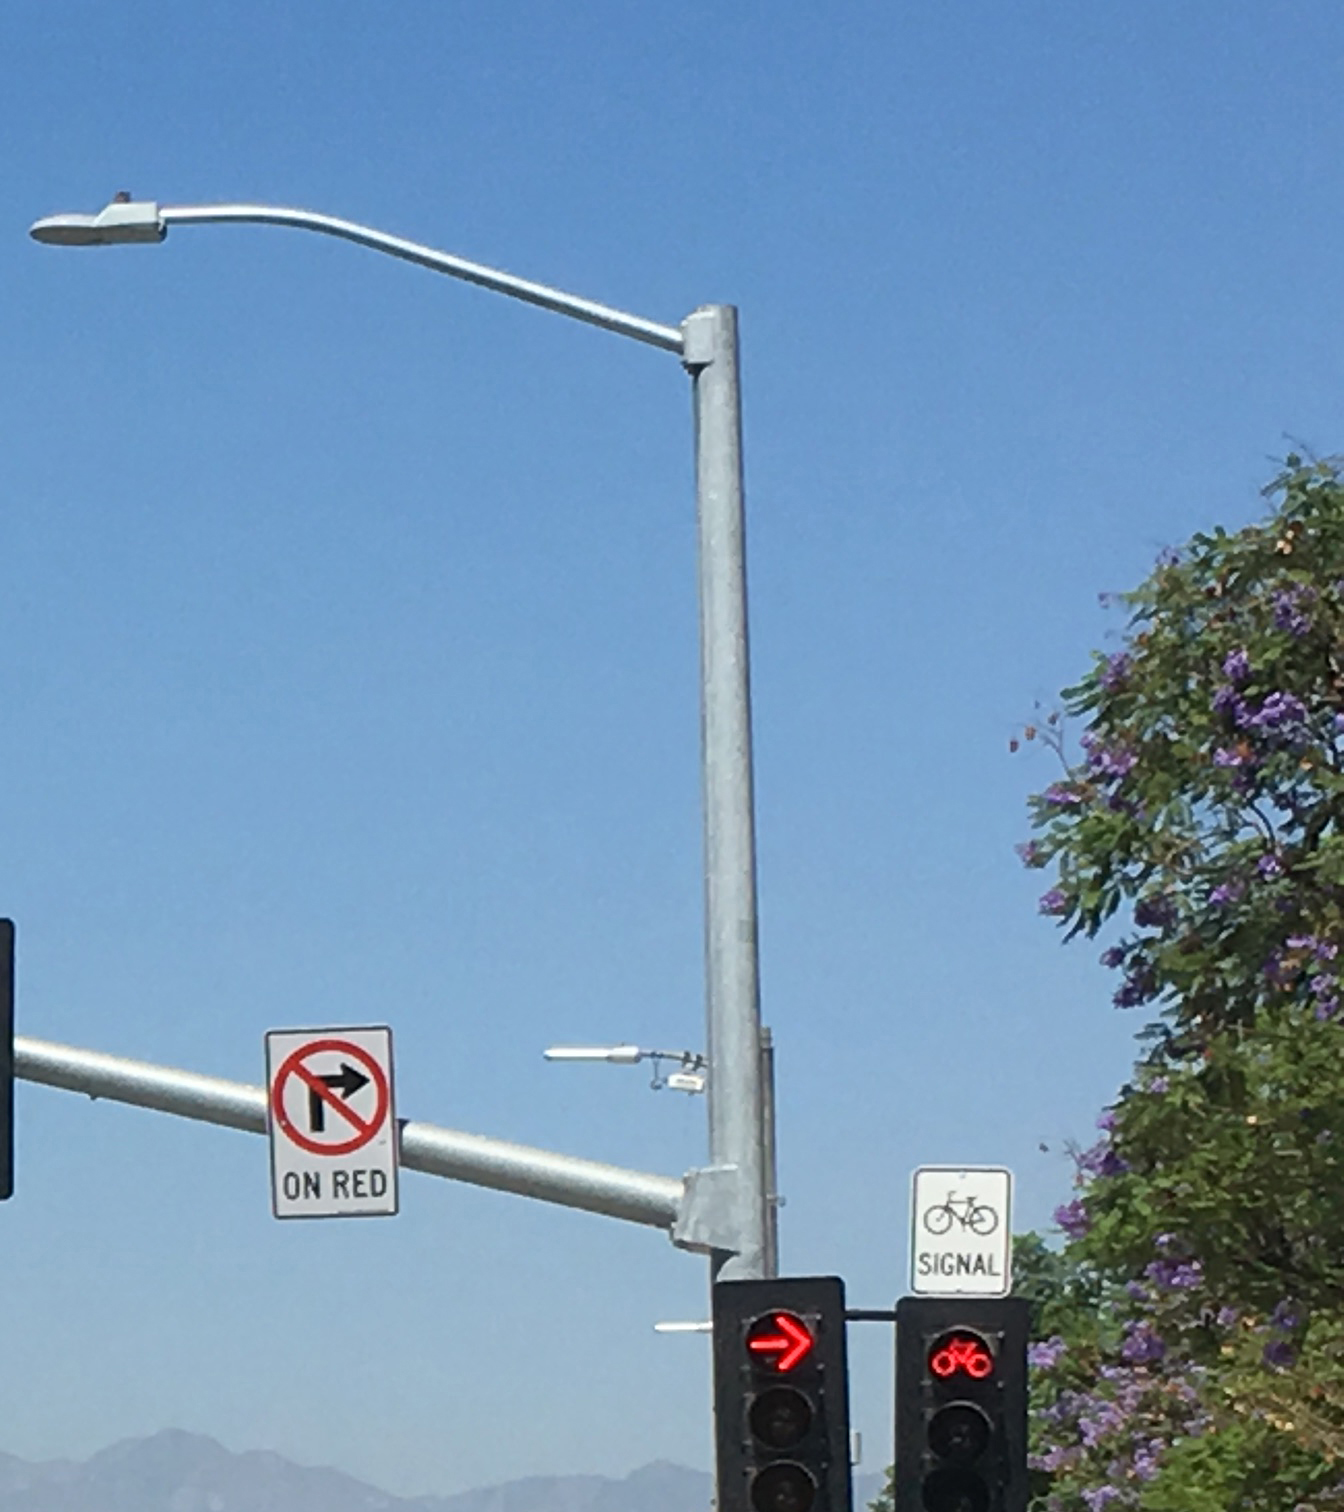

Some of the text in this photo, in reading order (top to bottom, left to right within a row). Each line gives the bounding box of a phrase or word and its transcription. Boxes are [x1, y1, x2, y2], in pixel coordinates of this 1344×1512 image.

[283, 1169, 387, 1200] ON RED
[918, 1252, 1001, 1276] SIGNAL
